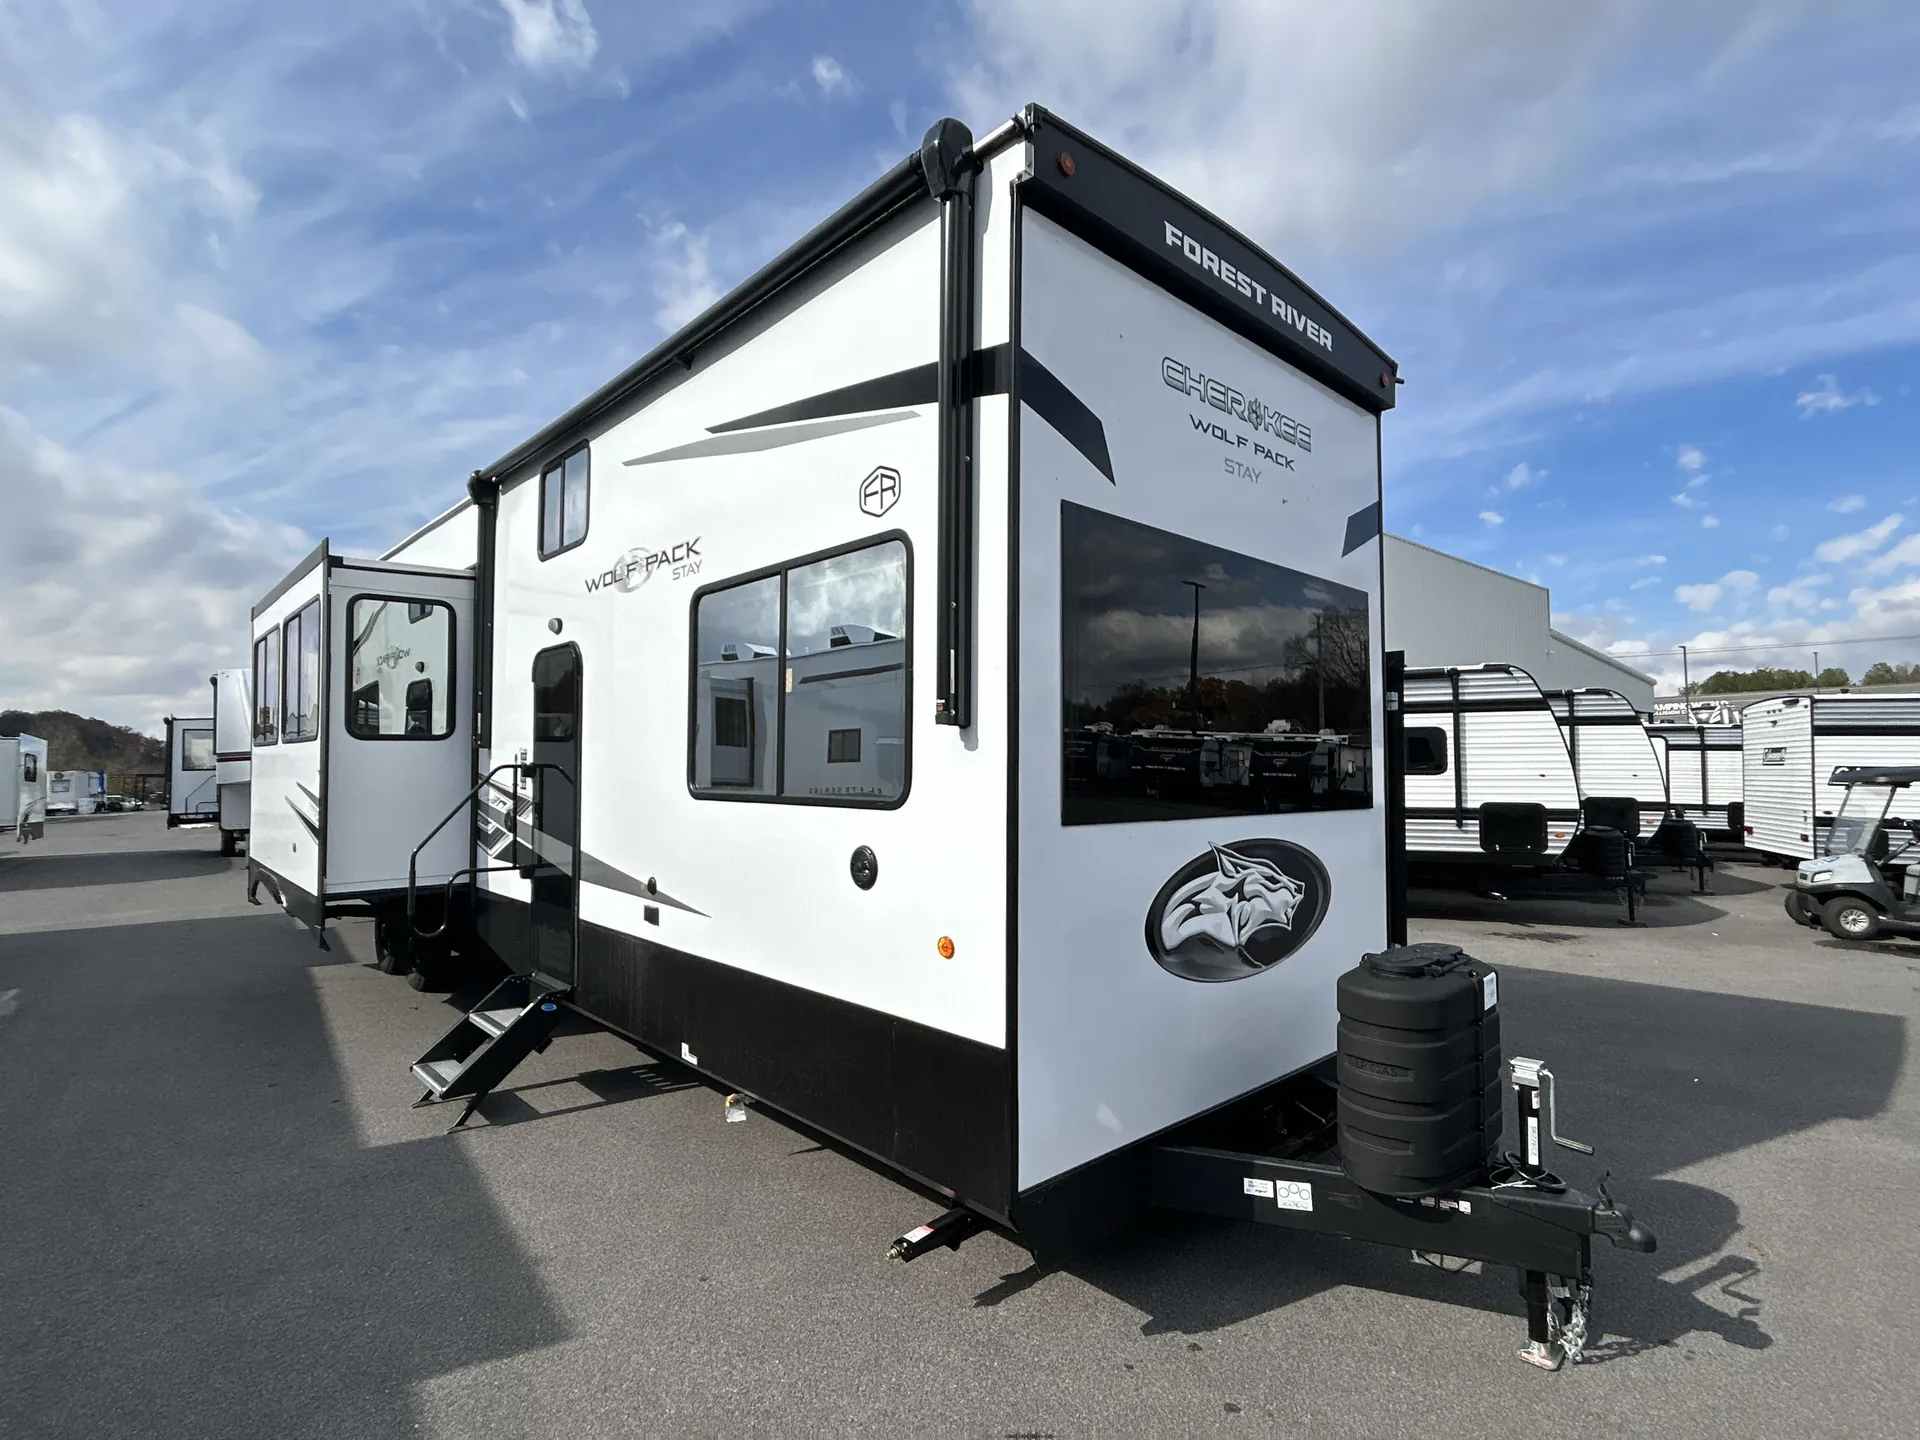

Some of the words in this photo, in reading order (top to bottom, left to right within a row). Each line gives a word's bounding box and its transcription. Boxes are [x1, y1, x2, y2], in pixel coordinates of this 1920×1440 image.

[1164, 220, 1267, 305] FOREST
[1270, 292, 1333, 352] RIVER
[1189, 413, 1248, 448] WOLF
[1253, 442, 1295, 471] PACK
[1224, 458, 1262, 483] STAY
[864, 472, 897, 510] FR
[585, 560, 639, 594] WOLF
[645, 536, 702, 572] PACK
[672, 559, 703, 581] STAY
[1653, 703, 1688, 711] AMPING
[1371, 1064, 1398, 1077] GAS
